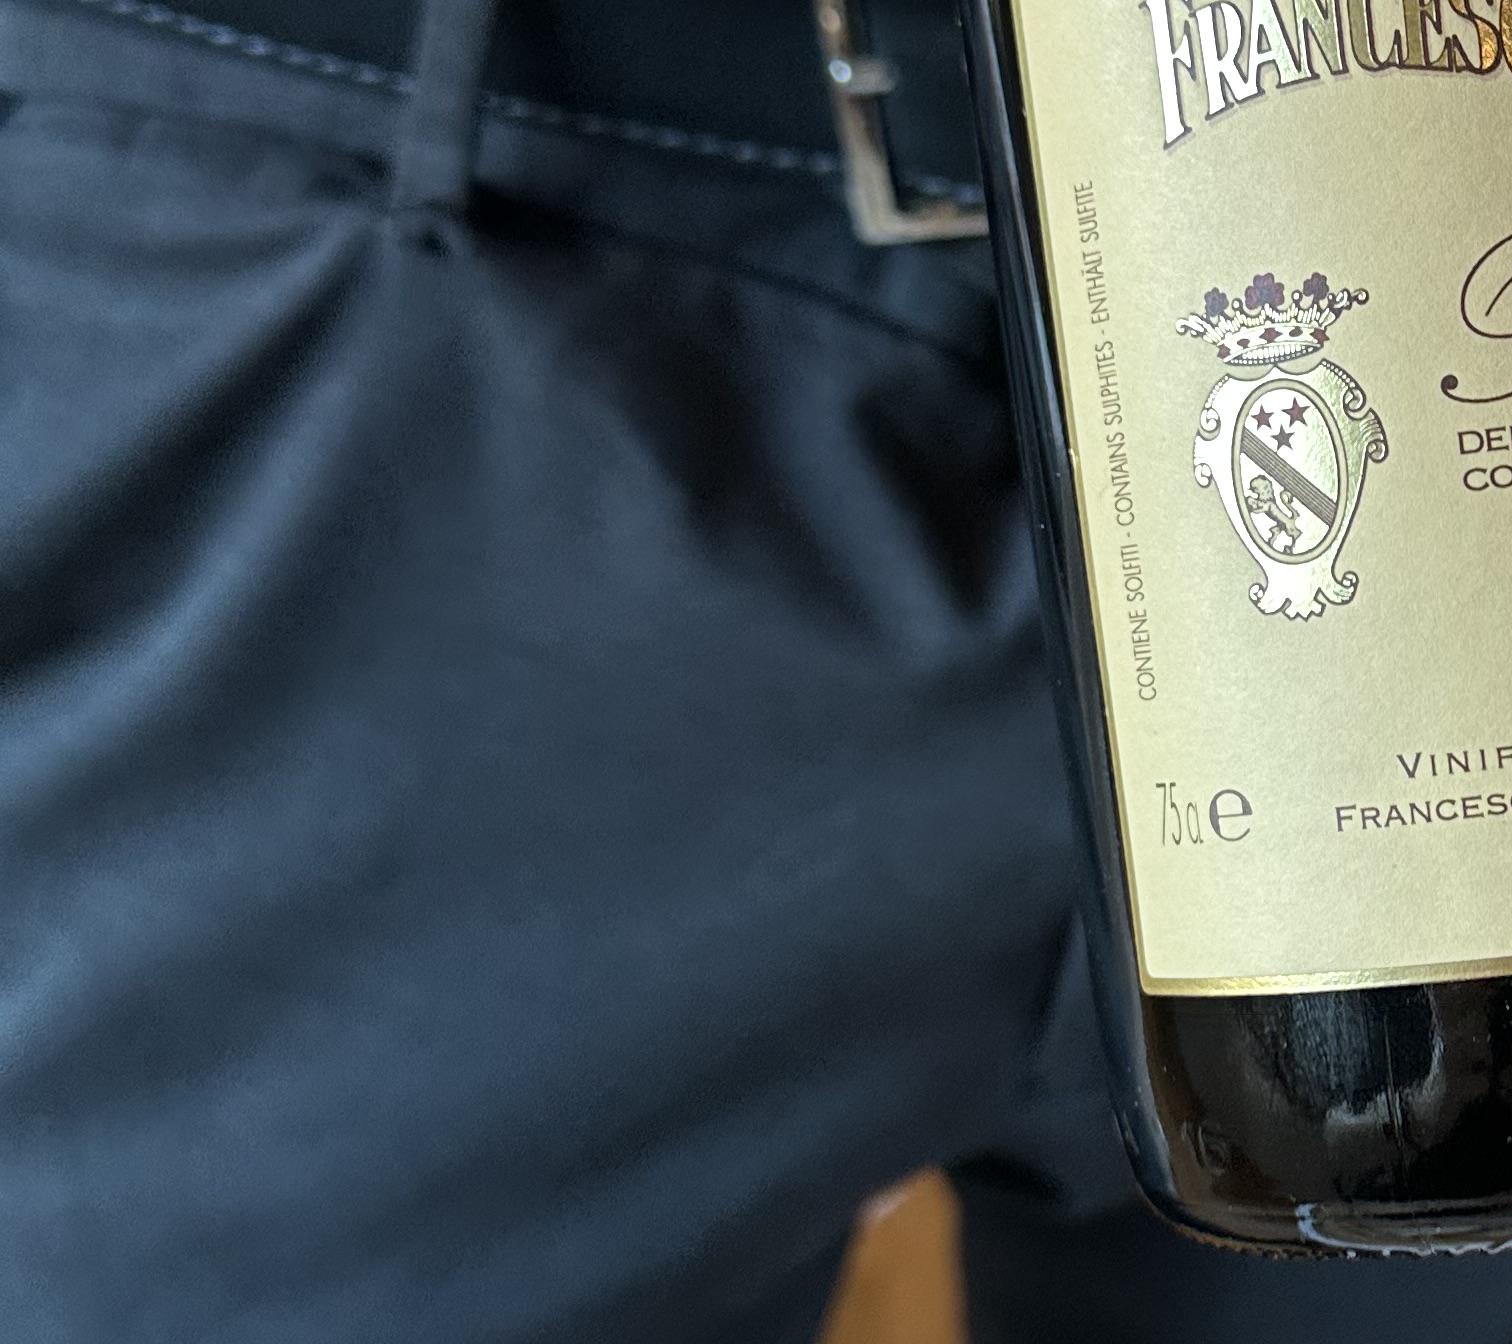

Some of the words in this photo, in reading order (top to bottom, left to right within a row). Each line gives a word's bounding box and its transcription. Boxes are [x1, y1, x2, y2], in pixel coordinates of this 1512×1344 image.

[1074, 179, 1100, 243] SULFITE
[1094, 340, 1123, 426] SULPHITES
[1106, 431, 1135, 527] CONTAINS
[1119, 543, 1145, 603] SOLFITI
[1127, 608, 1157, 701] CONTIENE
